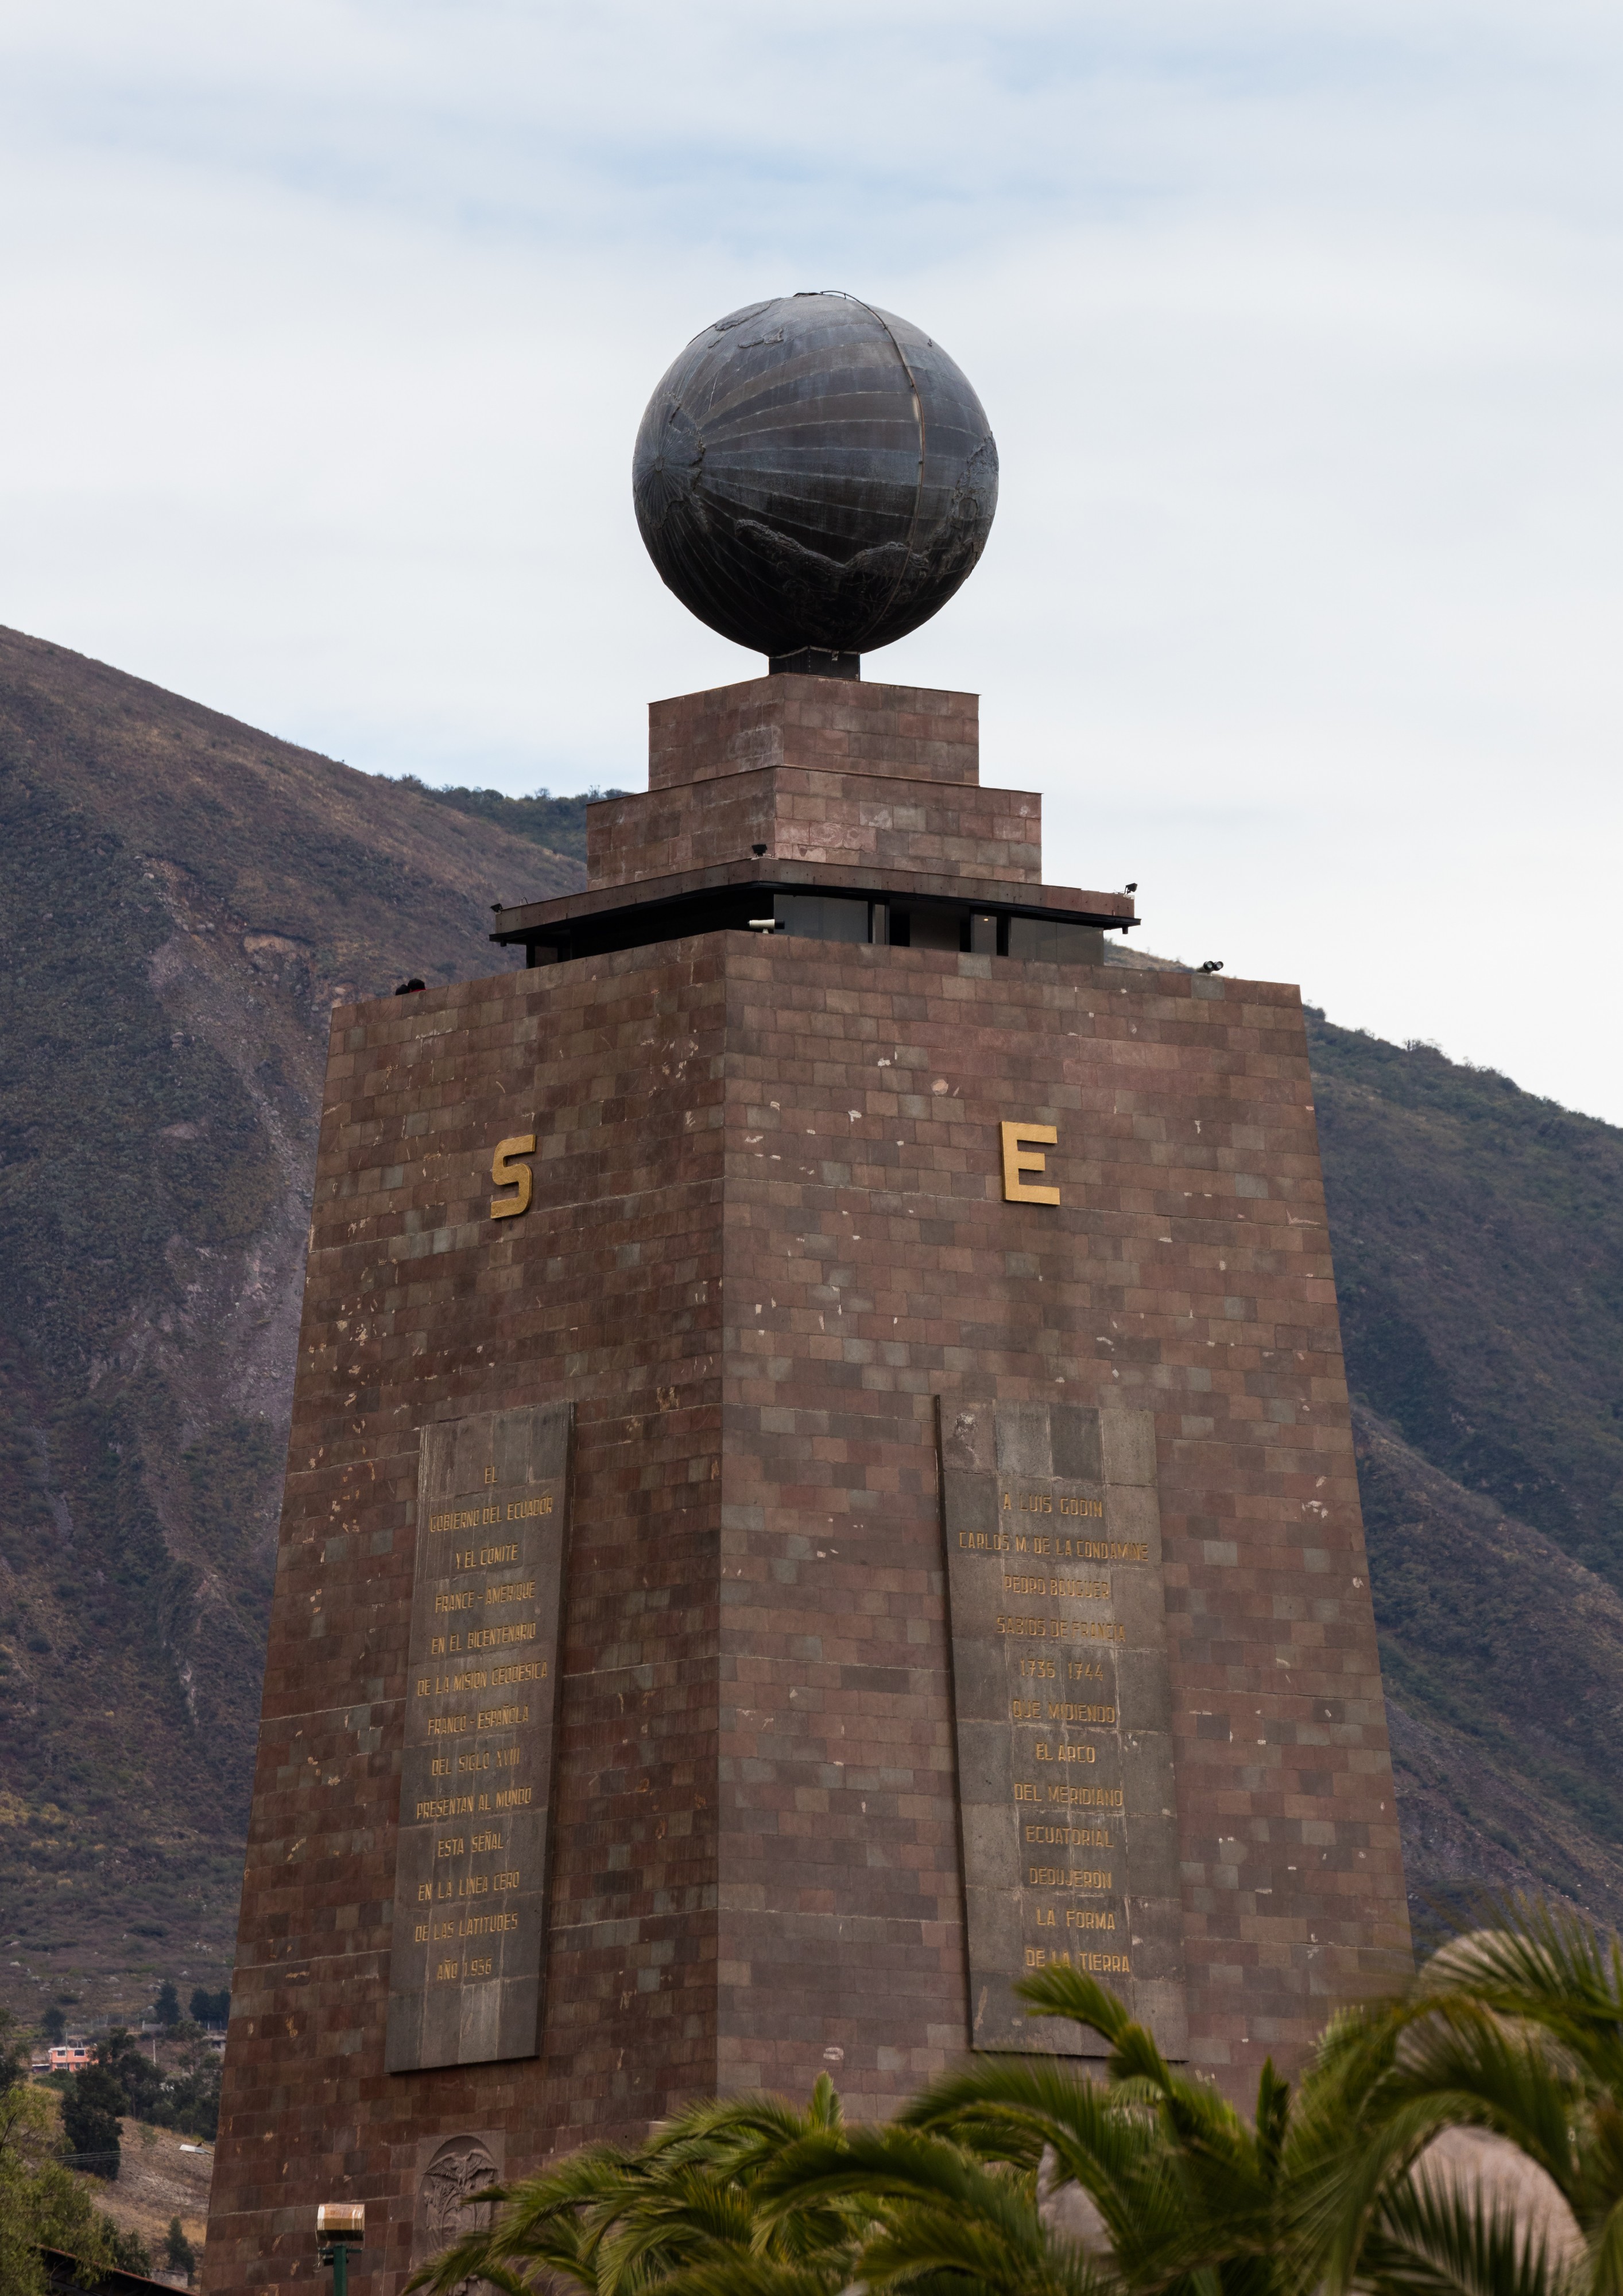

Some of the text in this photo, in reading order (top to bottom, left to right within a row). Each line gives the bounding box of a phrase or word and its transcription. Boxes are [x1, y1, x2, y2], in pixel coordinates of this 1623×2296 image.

[490, 1133, 536, 1219] S
[999, 1120, 1060, 1206] E
[485, 1466, 498, 1484] EL
[430, 1496, 553, 1533] GOBIERNO DEL ECUADOR
[1003, 1492, 1102, 1518] A LUIS GODIN
[456, 1543, 518, 1569] Y EL COMITE
[959, 1530, 1148, 1561] CARLOS M. DE LA CONDAMINE
[435, 1590, 474, 1613] FRANCE
[486, 1580, 536, 1605] AMERIQUE
[1005, 1575, 1109, 1599] PEDRO BOUGUER
[432, 1622, 536, 1654] EN EL BICENTENARIO
[996, 1616, 1125, 1642] SABIOS DE FRANCIA
[417, 1661, 547, 1696] DE LA MISION GEODESICA
[1068, 1662, 1103, 1681] 1.744
[428, 1714, 466, 1735] FRANCO
[478, 1704, 529, 1729] ESPAÑOLA
[1013, 1700, 1115, 1723] QUE MIDIENDO
[432, 1746, 520, 1776] DEL SIGLO XVIII
[1036, 1743, 1095, 1763] EL ARCO
[417, 1786, 532, 1820] PRESENTAN AL MUNDO
[1014, 1783, 1123, 1806] DEL MERIDIANO
[438, 1830, 504, 1857] ESTA SEÑAL
[1026, 1825, 1114, 1847] ECUATORIAL
[418, 1870, 520, 1901] EN LA LINEA CERO
[1029, 1867, 1111, 1888] DEDUJERON
[415, 1912, 518, 1942] DE LAS LATITUDES
[1036, 1907, 1115, 1930] LA FORMA
[436, 1957, 492, 1980] AÑO 1.936
[1026, 1948, 1130, 1972] DE LA TIERRA
